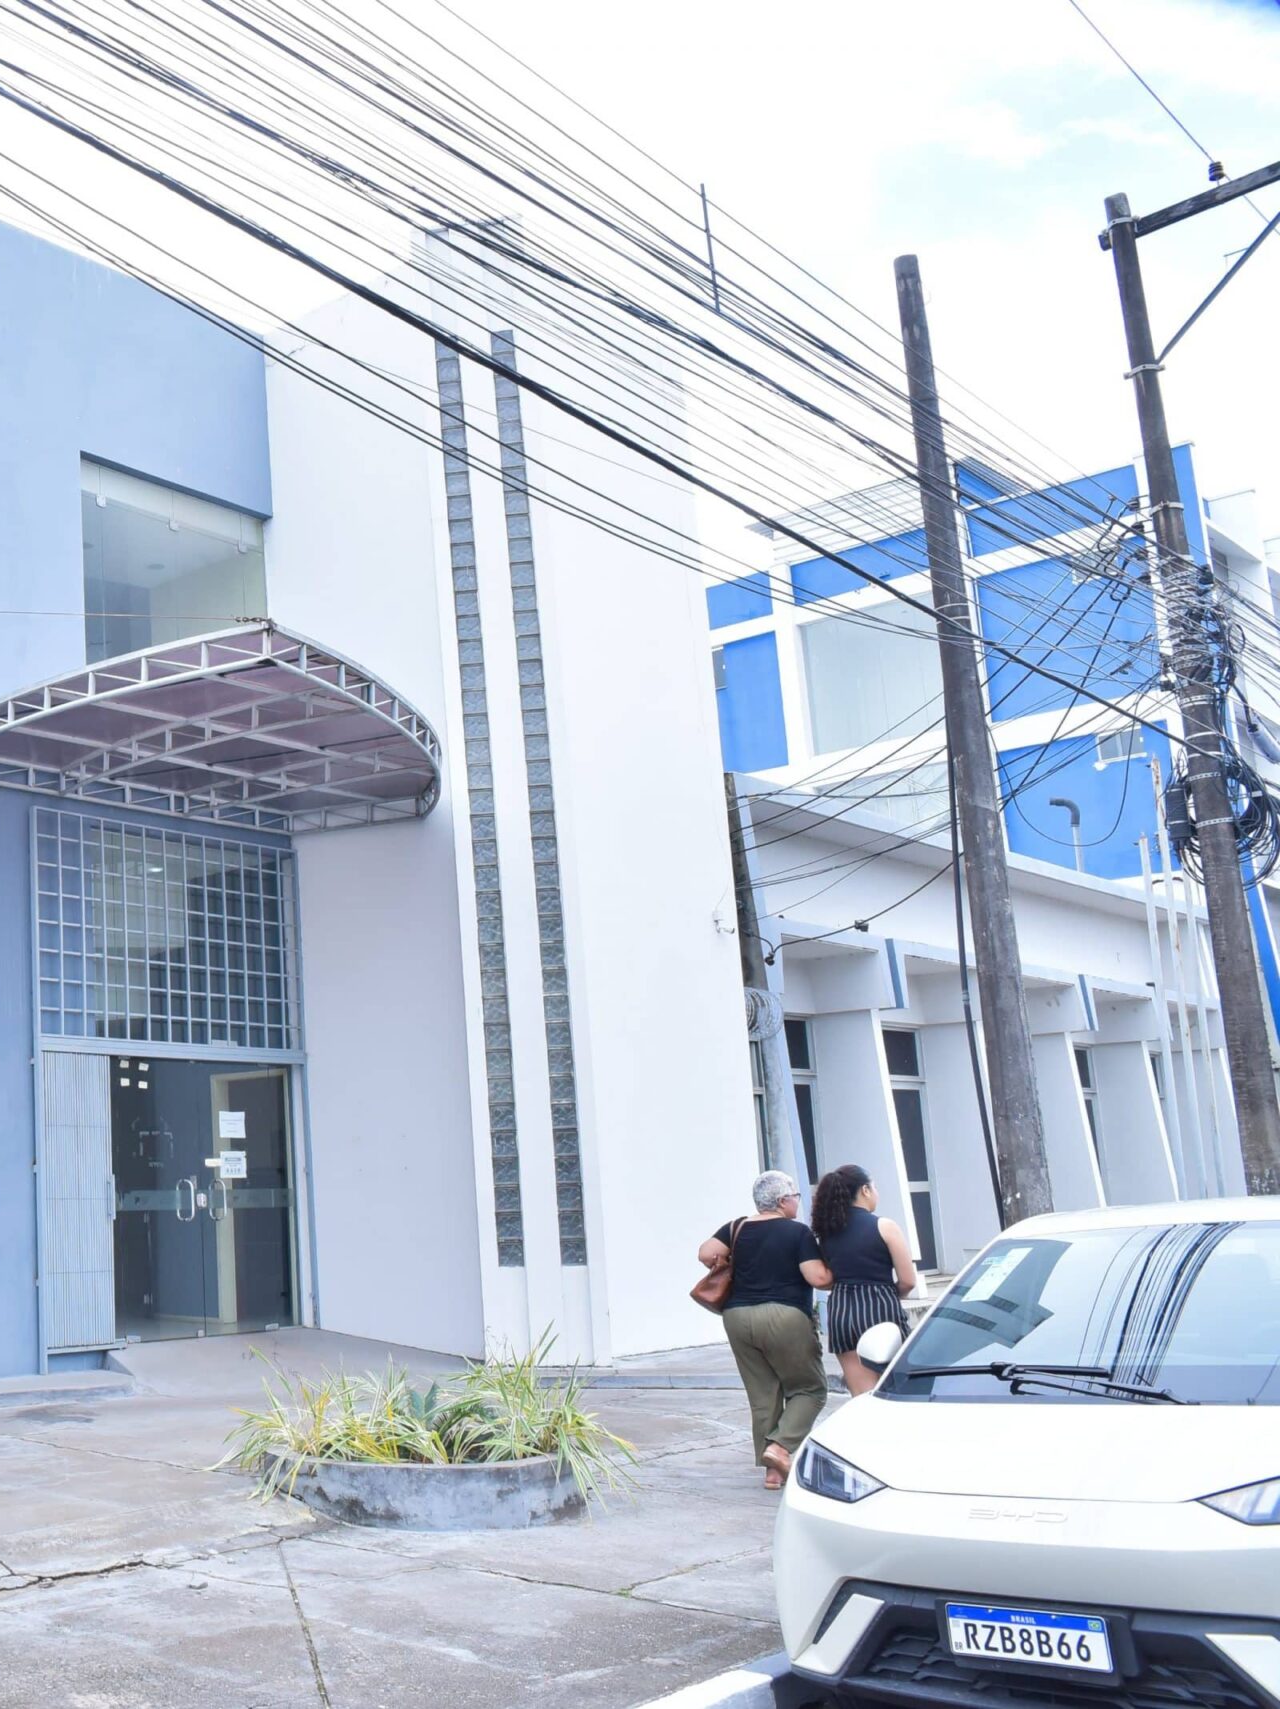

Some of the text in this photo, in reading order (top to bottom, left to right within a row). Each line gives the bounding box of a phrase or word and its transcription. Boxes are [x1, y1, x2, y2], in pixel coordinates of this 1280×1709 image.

[968, 1508, 1068, 1524] BYD
[1010, 1615, 1036, 1625] BRASIL
[964, 1623, 1091, 1662] RZB8B66
